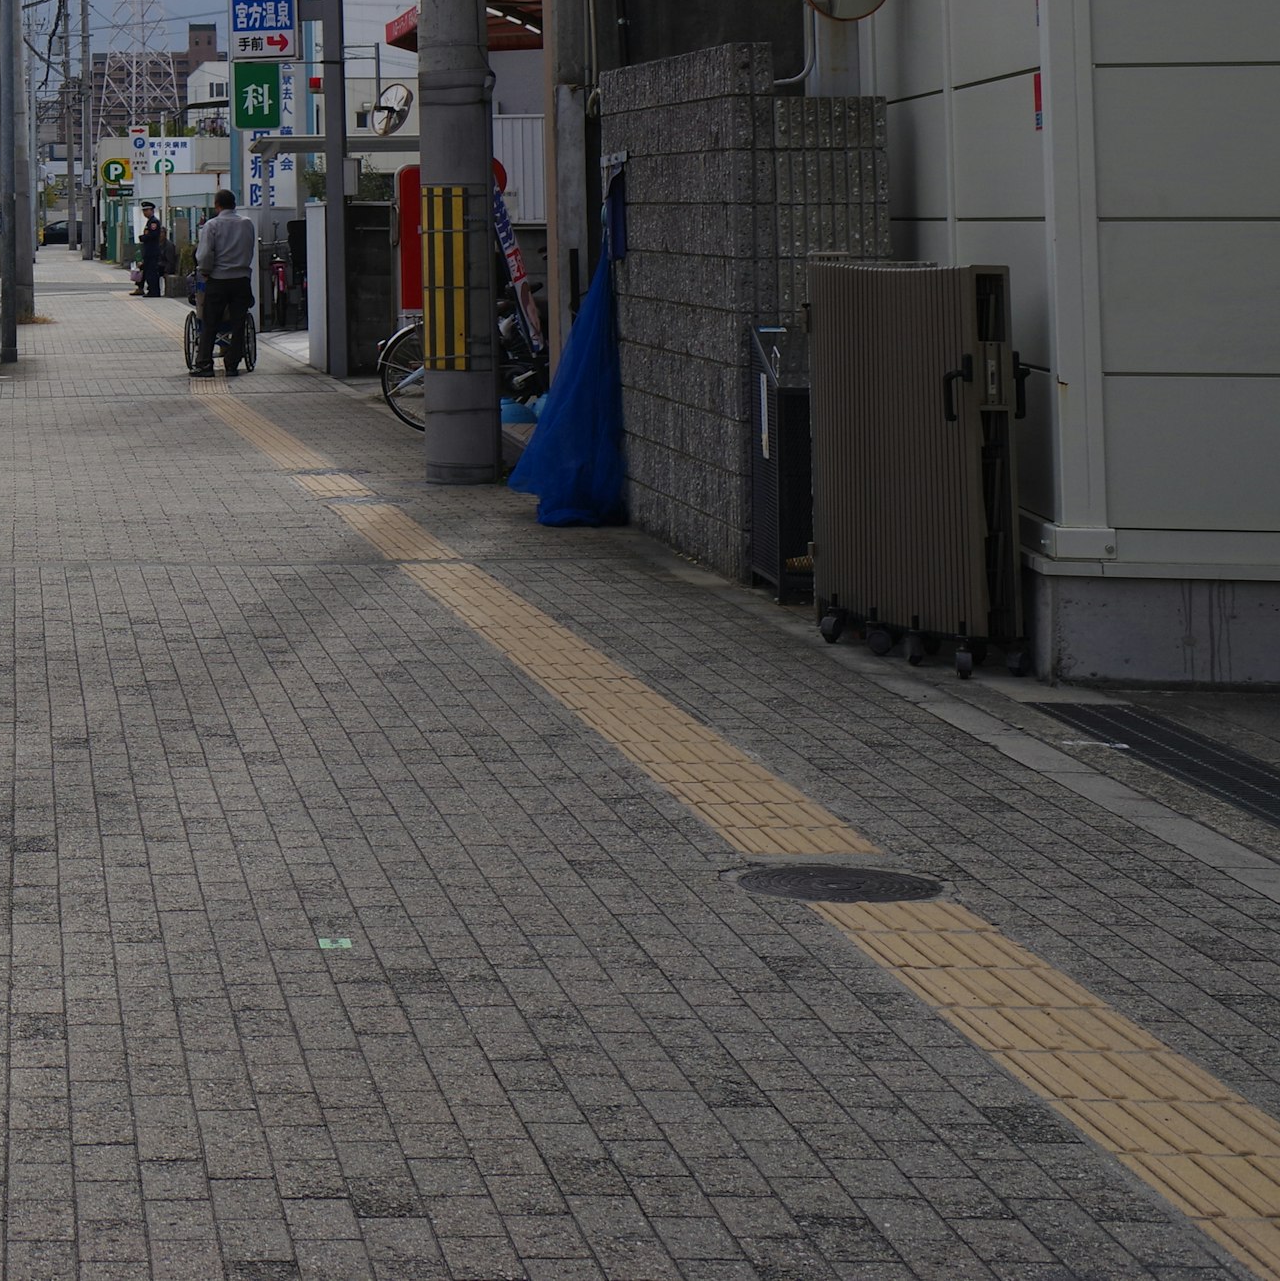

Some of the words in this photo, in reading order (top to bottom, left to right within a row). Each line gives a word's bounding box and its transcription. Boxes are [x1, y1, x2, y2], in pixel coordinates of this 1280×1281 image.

[238, 37, 263, 52] 手前
[242, 83, 274, 115] 科
[109, 164, 123, 180] P
